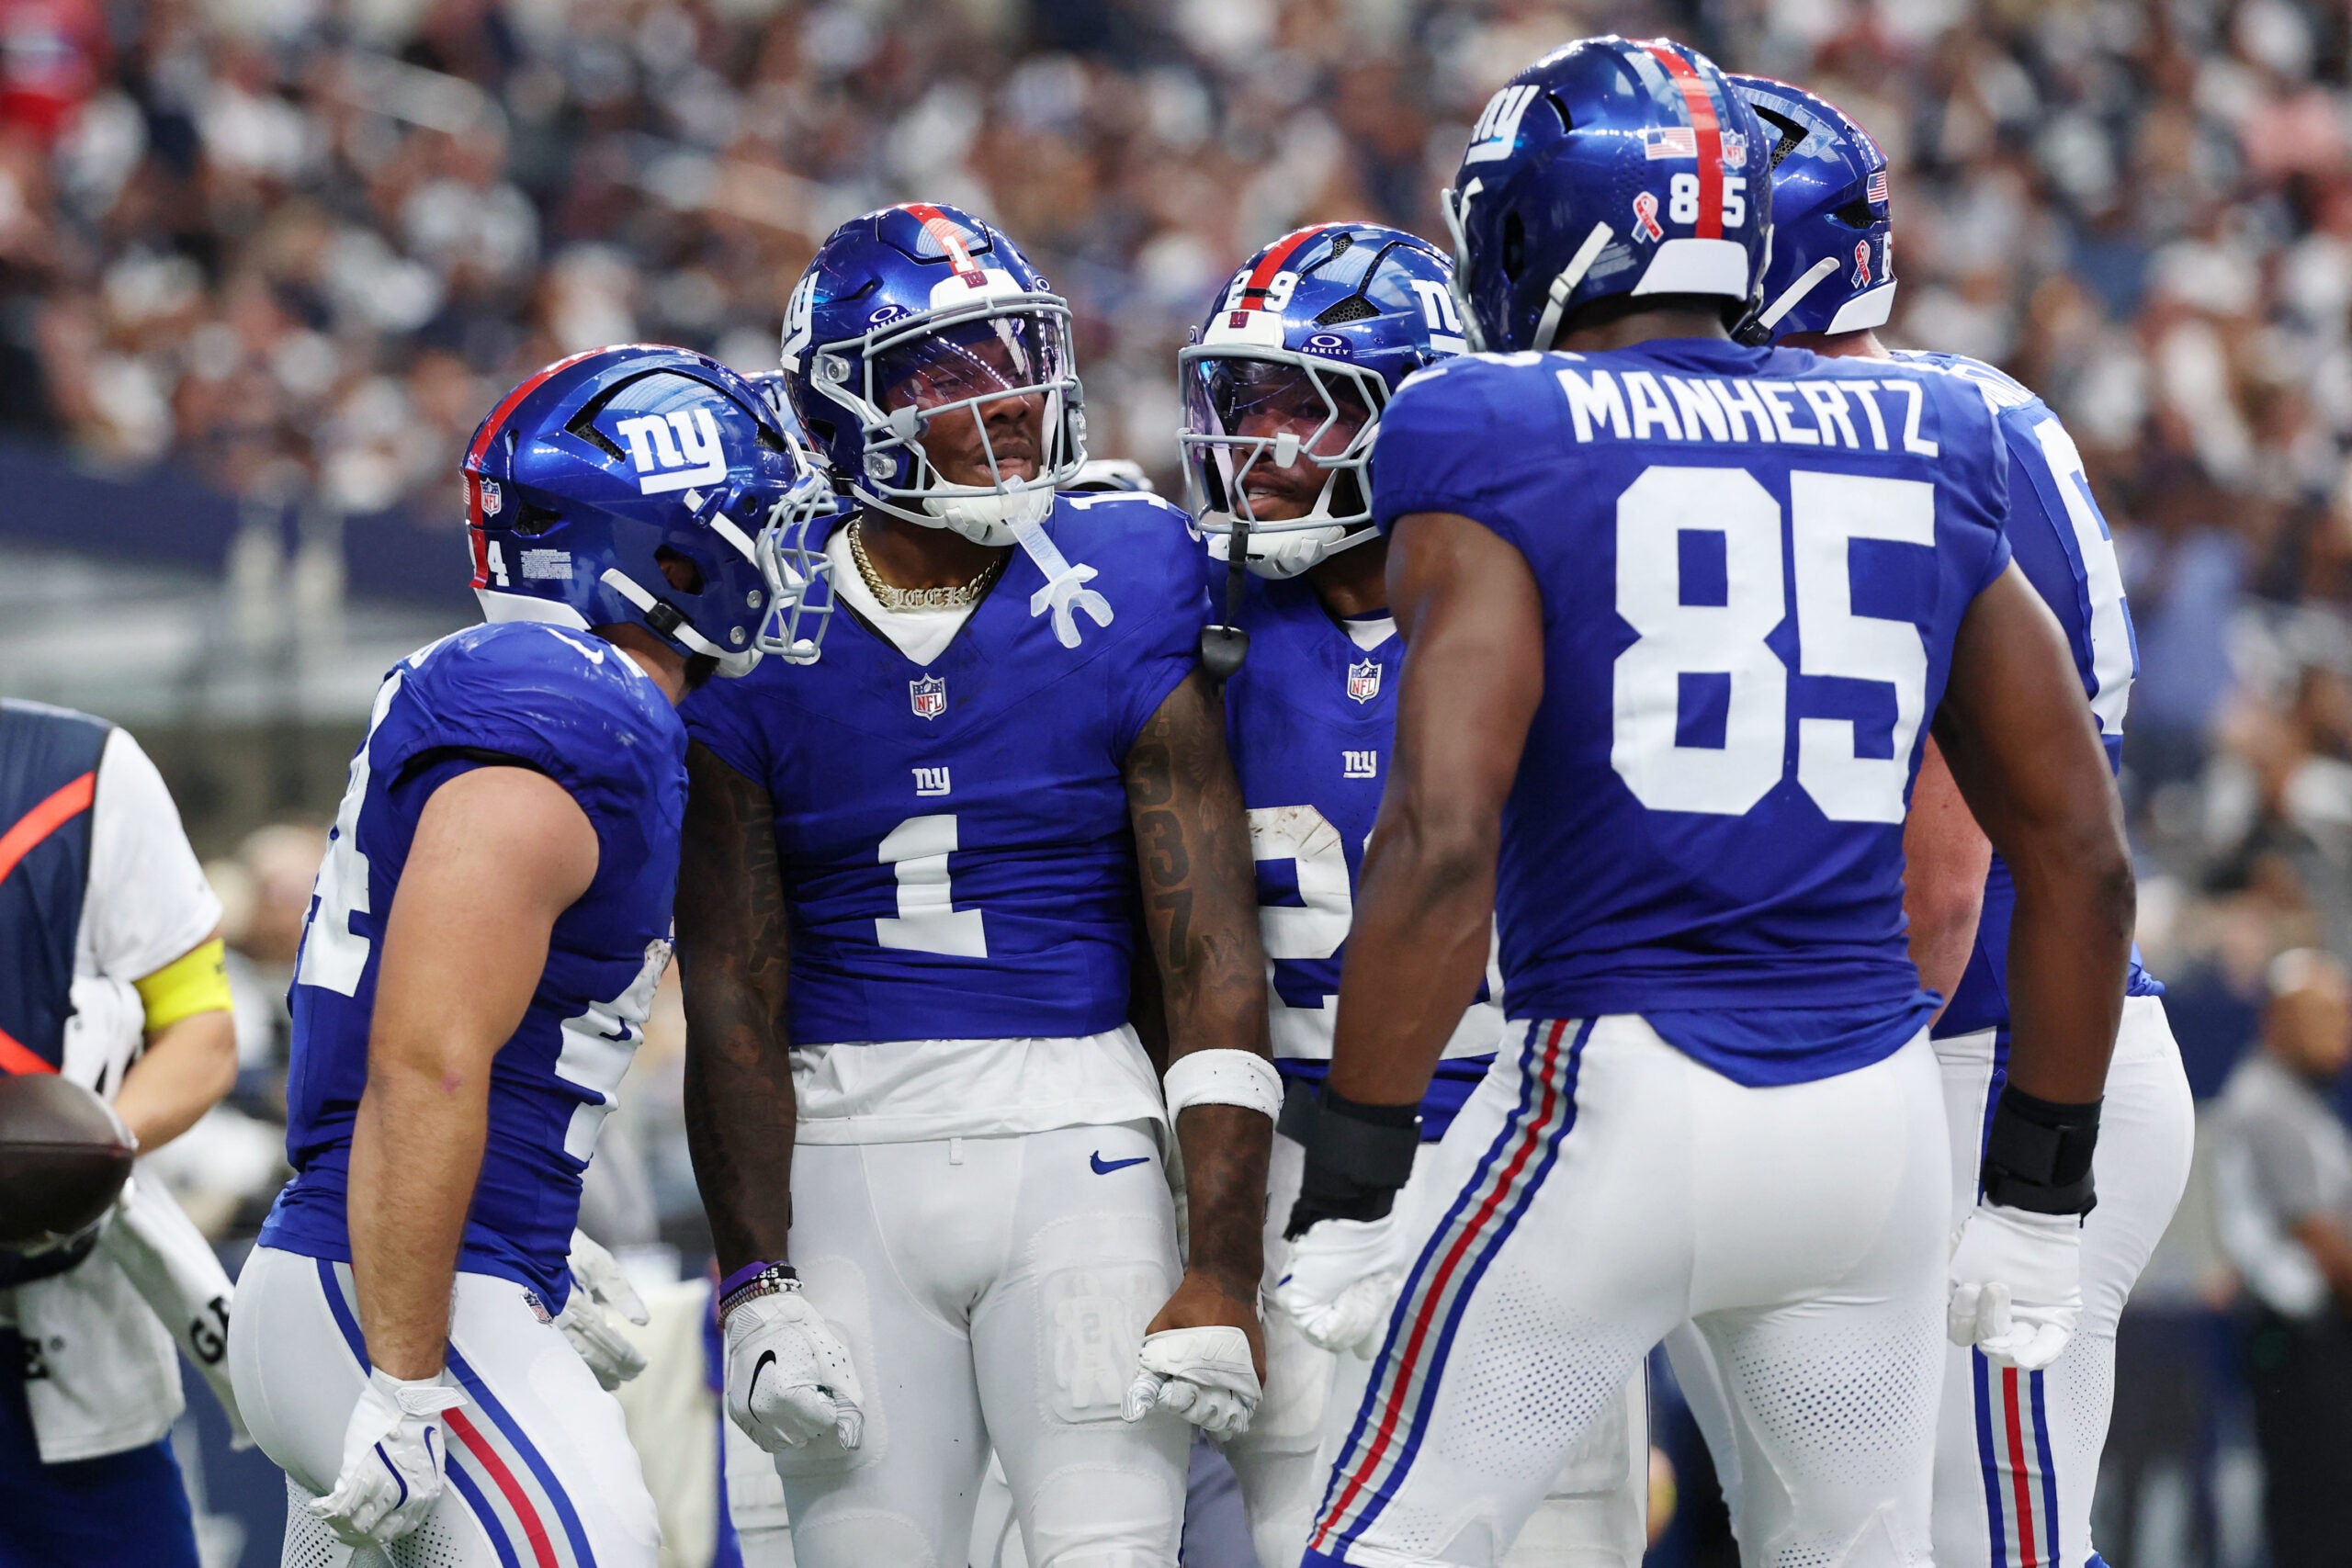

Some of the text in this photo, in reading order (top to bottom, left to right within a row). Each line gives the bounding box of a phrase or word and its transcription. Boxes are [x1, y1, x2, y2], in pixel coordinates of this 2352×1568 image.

[1465, 85, 1540, 164] ny
[1669, 173, 1747, 228] 85
[943, 236, 974, 272] 1
[1223, 269, 1298, 312] 29
[1303, 346, 1347, 355] OAKLEY
[1555, 368, 1939, 458] MANHERTZ
[616, 409, 727, 494] ny
[483, 494, 499, 511] NFL
[1611, 465, 1936, 825] 85
[916, 694, 941, 713] NFL
[1351, 678, 1374, 696] NFL
[911, 766, 951, 796] ny
[1341, 750, 1377, 779] ny
[875, 814, 989, 959] 1
